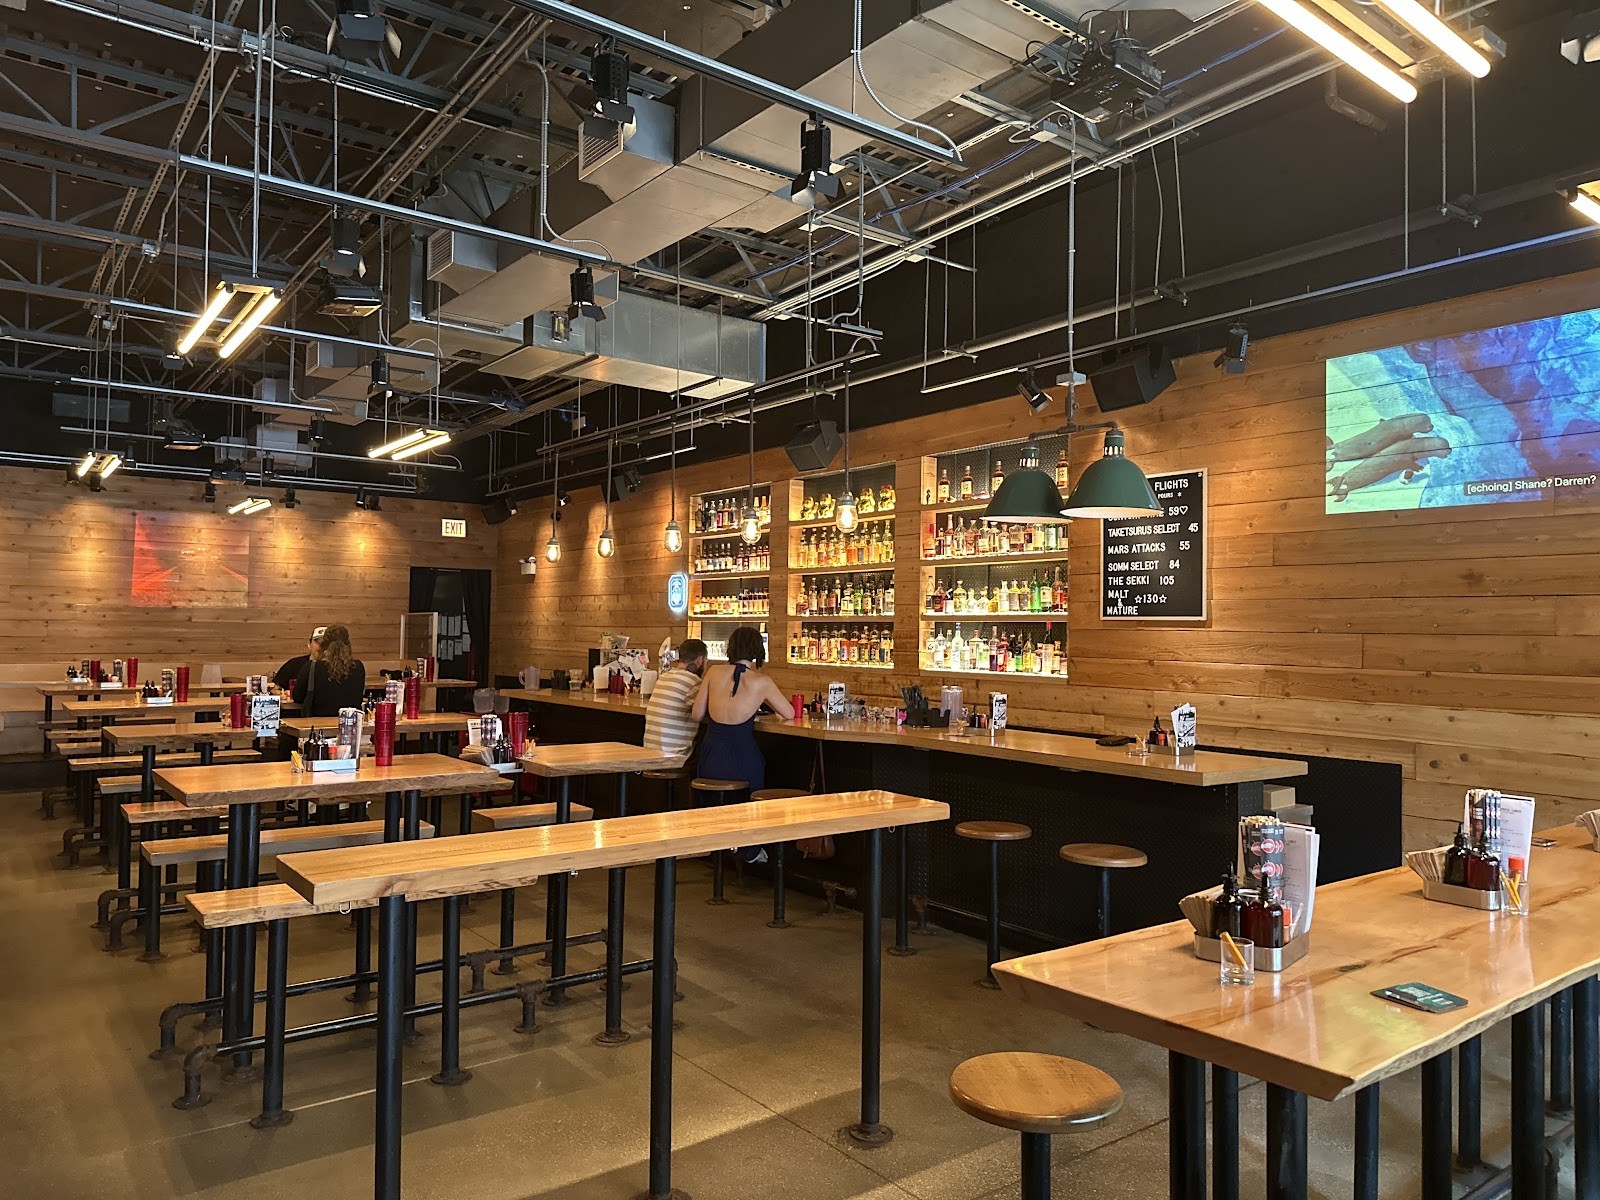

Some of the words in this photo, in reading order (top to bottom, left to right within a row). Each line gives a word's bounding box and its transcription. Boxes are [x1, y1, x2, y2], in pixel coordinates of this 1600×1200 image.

[1154, 478, 1189, 491] FLIGHTS
[1467, 481, 1513, 494] [echoing]
[1514, 478, 1552, 490] Shane?
[1554, 475, 1597, 487] Darren?
[445, 521, 463, 534] EXIT
[1107, 525, 1152, 538] TAKETSURUS
[1153, 522, 1181, 535] SELECT
[1188, 522, 1199, 533] 45
[1107, 544, 1129, 555] MARS
[1131, 542, 1166, 554] ATTACKS
[1179, 540, 1191, 551] 55
[1107, 561, 1129, 572] SOMM
[1130, 560, 1160, 571] SELECT
[1168, 559, 1181, 570] 84
[1107, 576, 1124, 586] THE
[1125, 575, 1150, 586] SEKKI
[1159, 575, 1175, 586] 105
[1107, 589, 1130, 599] MALT
[1117, 597, 1124, 607] &
[1106, 605, 1139, 615] MATURE
